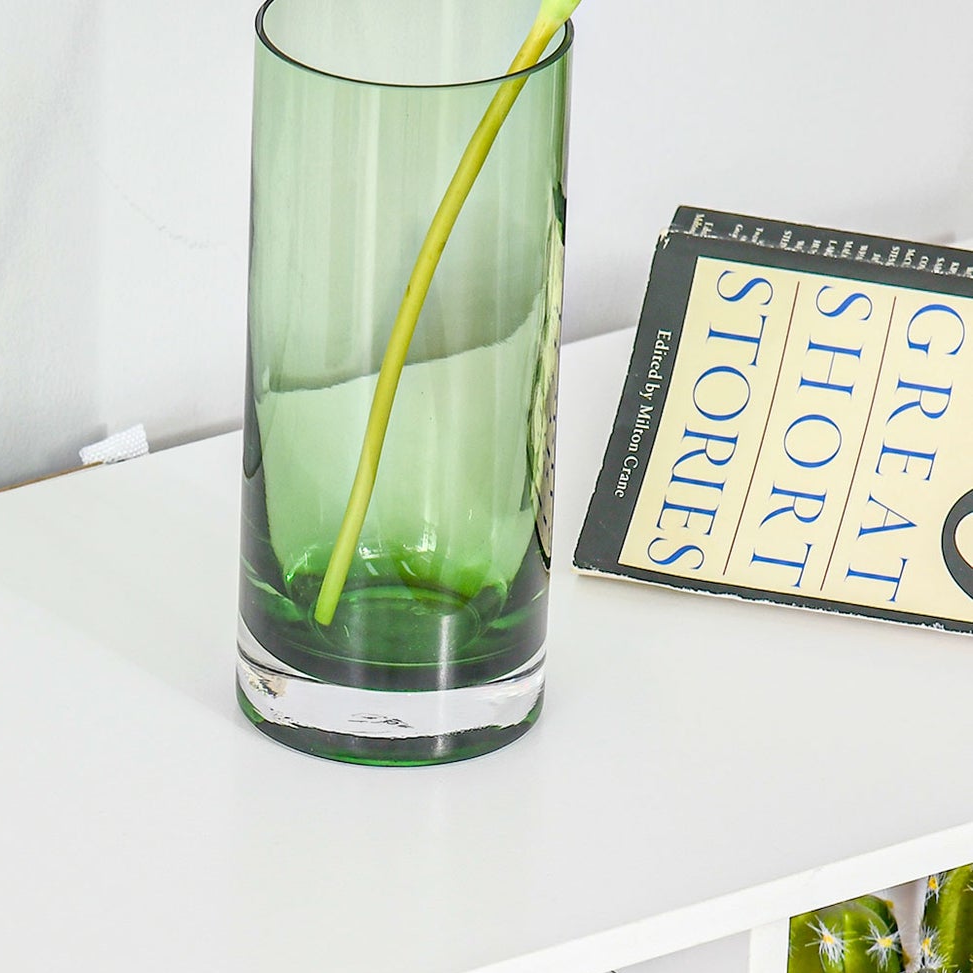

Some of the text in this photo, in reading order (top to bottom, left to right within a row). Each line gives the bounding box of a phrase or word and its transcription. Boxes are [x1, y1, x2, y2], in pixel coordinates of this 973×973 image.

[614, 330, 672, 498] Edited by Milton Crane
[646, 269, 774, 570] STORIES
[751, 285, 873, 588] SHORT
[846, 303, 966, 603] GREAT
